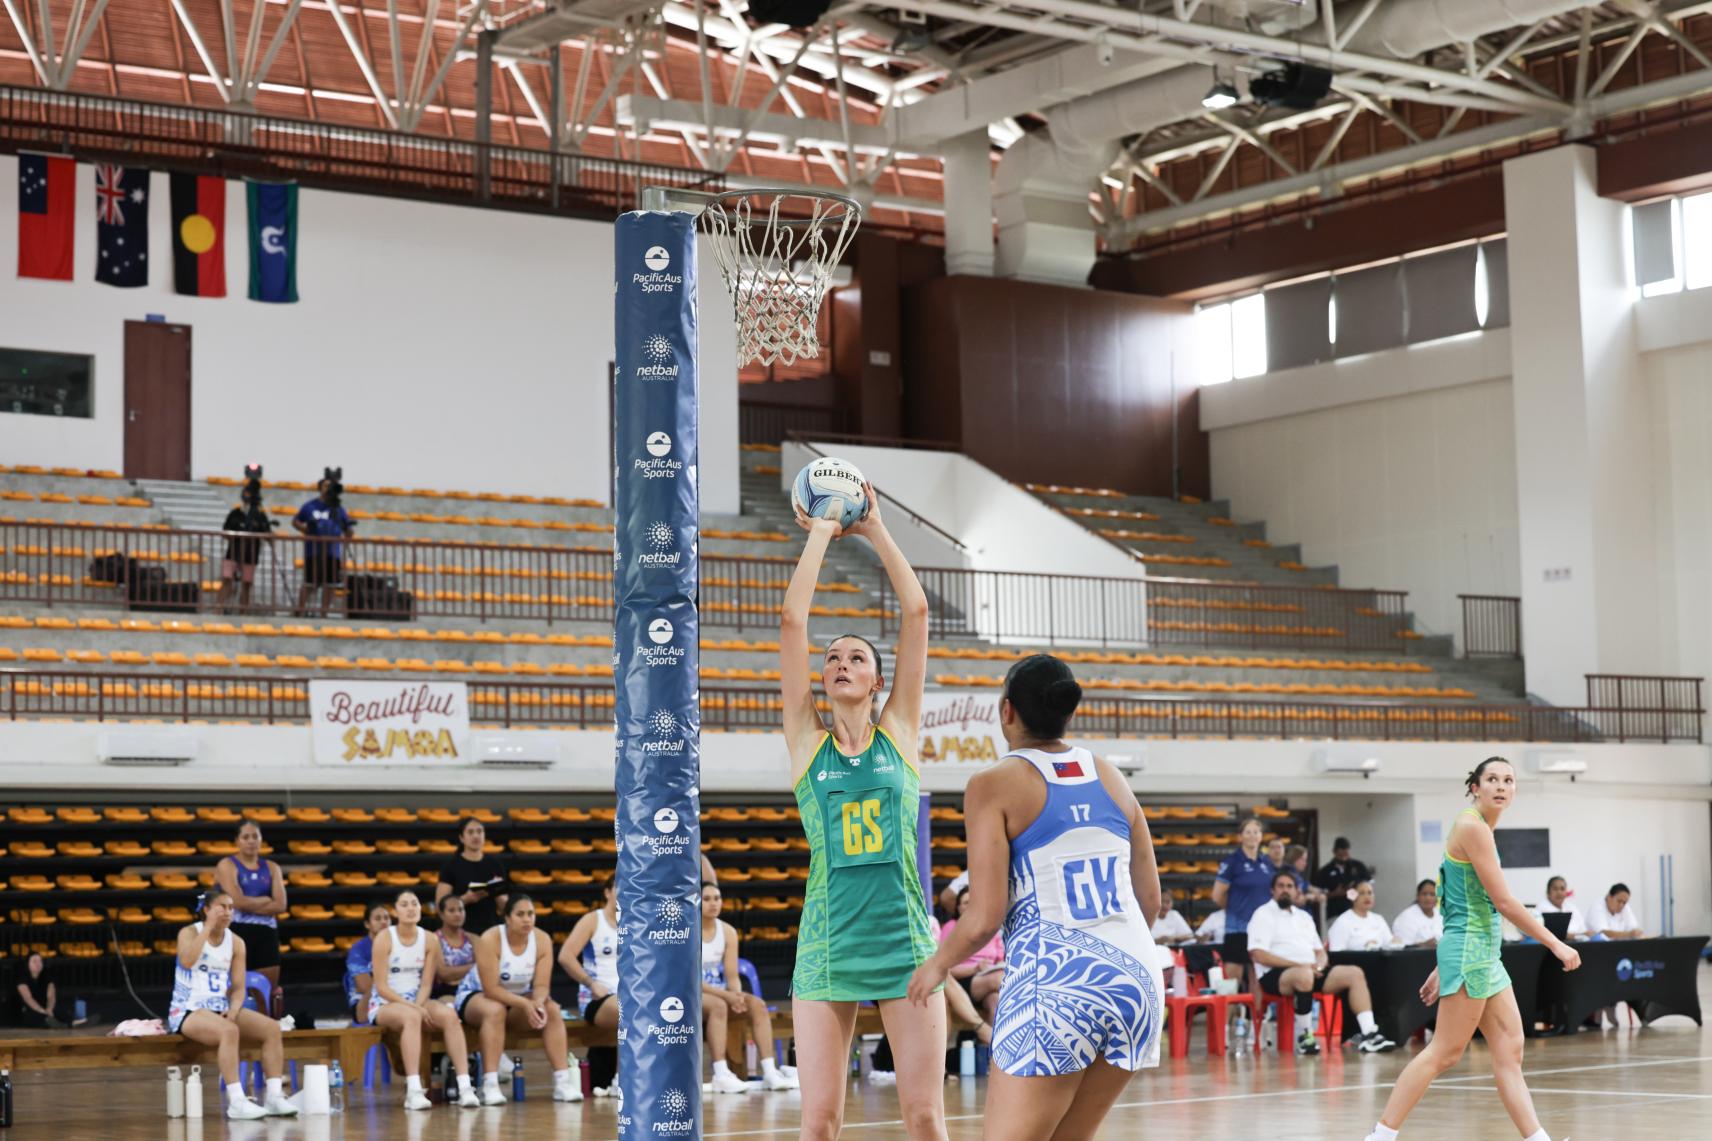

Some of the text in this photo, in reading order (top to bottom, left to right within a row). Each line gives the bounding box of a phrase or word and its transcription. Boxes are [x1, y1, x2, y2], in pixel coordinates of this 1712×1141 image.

[633, 273, 682, 283] PacificAus
[641, 282, 673, 293] Sports
[636, 364, 679, 376] netball
[634, 458, 682, 469] PacificAus
[643, 468, 675, 479] Sports
[814, 469, 863, 486] GILBER
[638, 552, 680, 563] netball
[636, 645, 685, 656] PacificAus
[646, 655, 677, 667] Sports
[326, 683, 455, 725] Beautiful
[342, 726, 458, 761] SAMOA
[641, 739, 684, 751] netball
[918, 735, 999, 763] AMOA
[1070, 804, 1091, 823] 17
[842, 799, 883, 856] GS
[642, 834, 690, 846] PacificAus
[651, 845, 683, 856] Sports
[1063, 857, 1125, 920] GK
[648, 927, 690, 940] netball
[208, 972, 220, 992] C
[647, 1024, 694, 1035] PacificAus
[657, 1034, 688, 1046] Sports
[652, 1117, 694, 1132] netball
